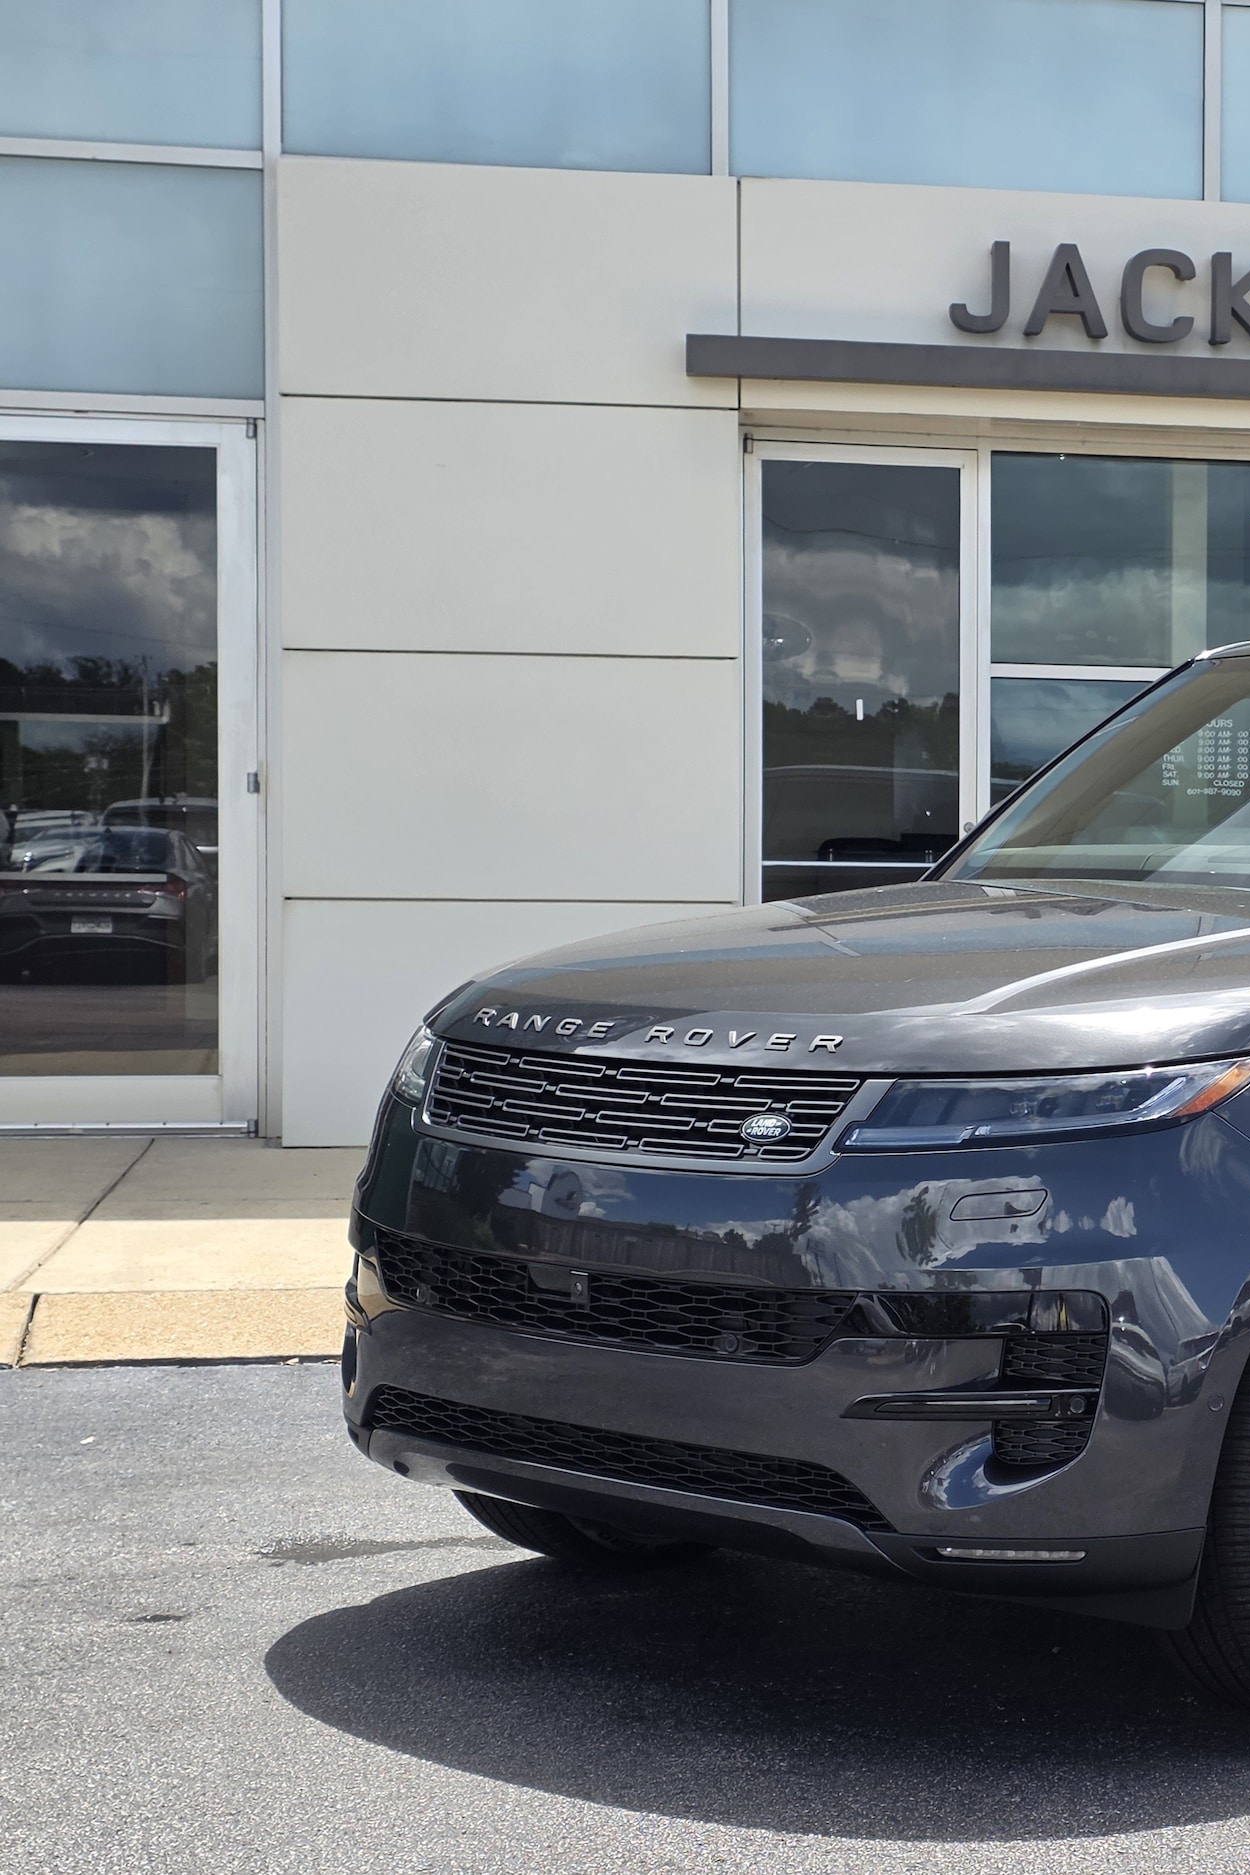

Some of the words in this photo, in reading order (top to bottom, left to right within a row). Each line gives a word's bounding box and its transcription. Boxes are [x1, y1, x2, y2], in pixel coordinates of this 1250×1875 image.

[1213, 779, 1245, 788] CLOSED
[472, 1007, 616, 1039] RANGE
[644, 1026, 844, 1054] ROVER
[751, 1118, 777, 1127] LAND
[750, 1127, 782, 1137] ROVER
